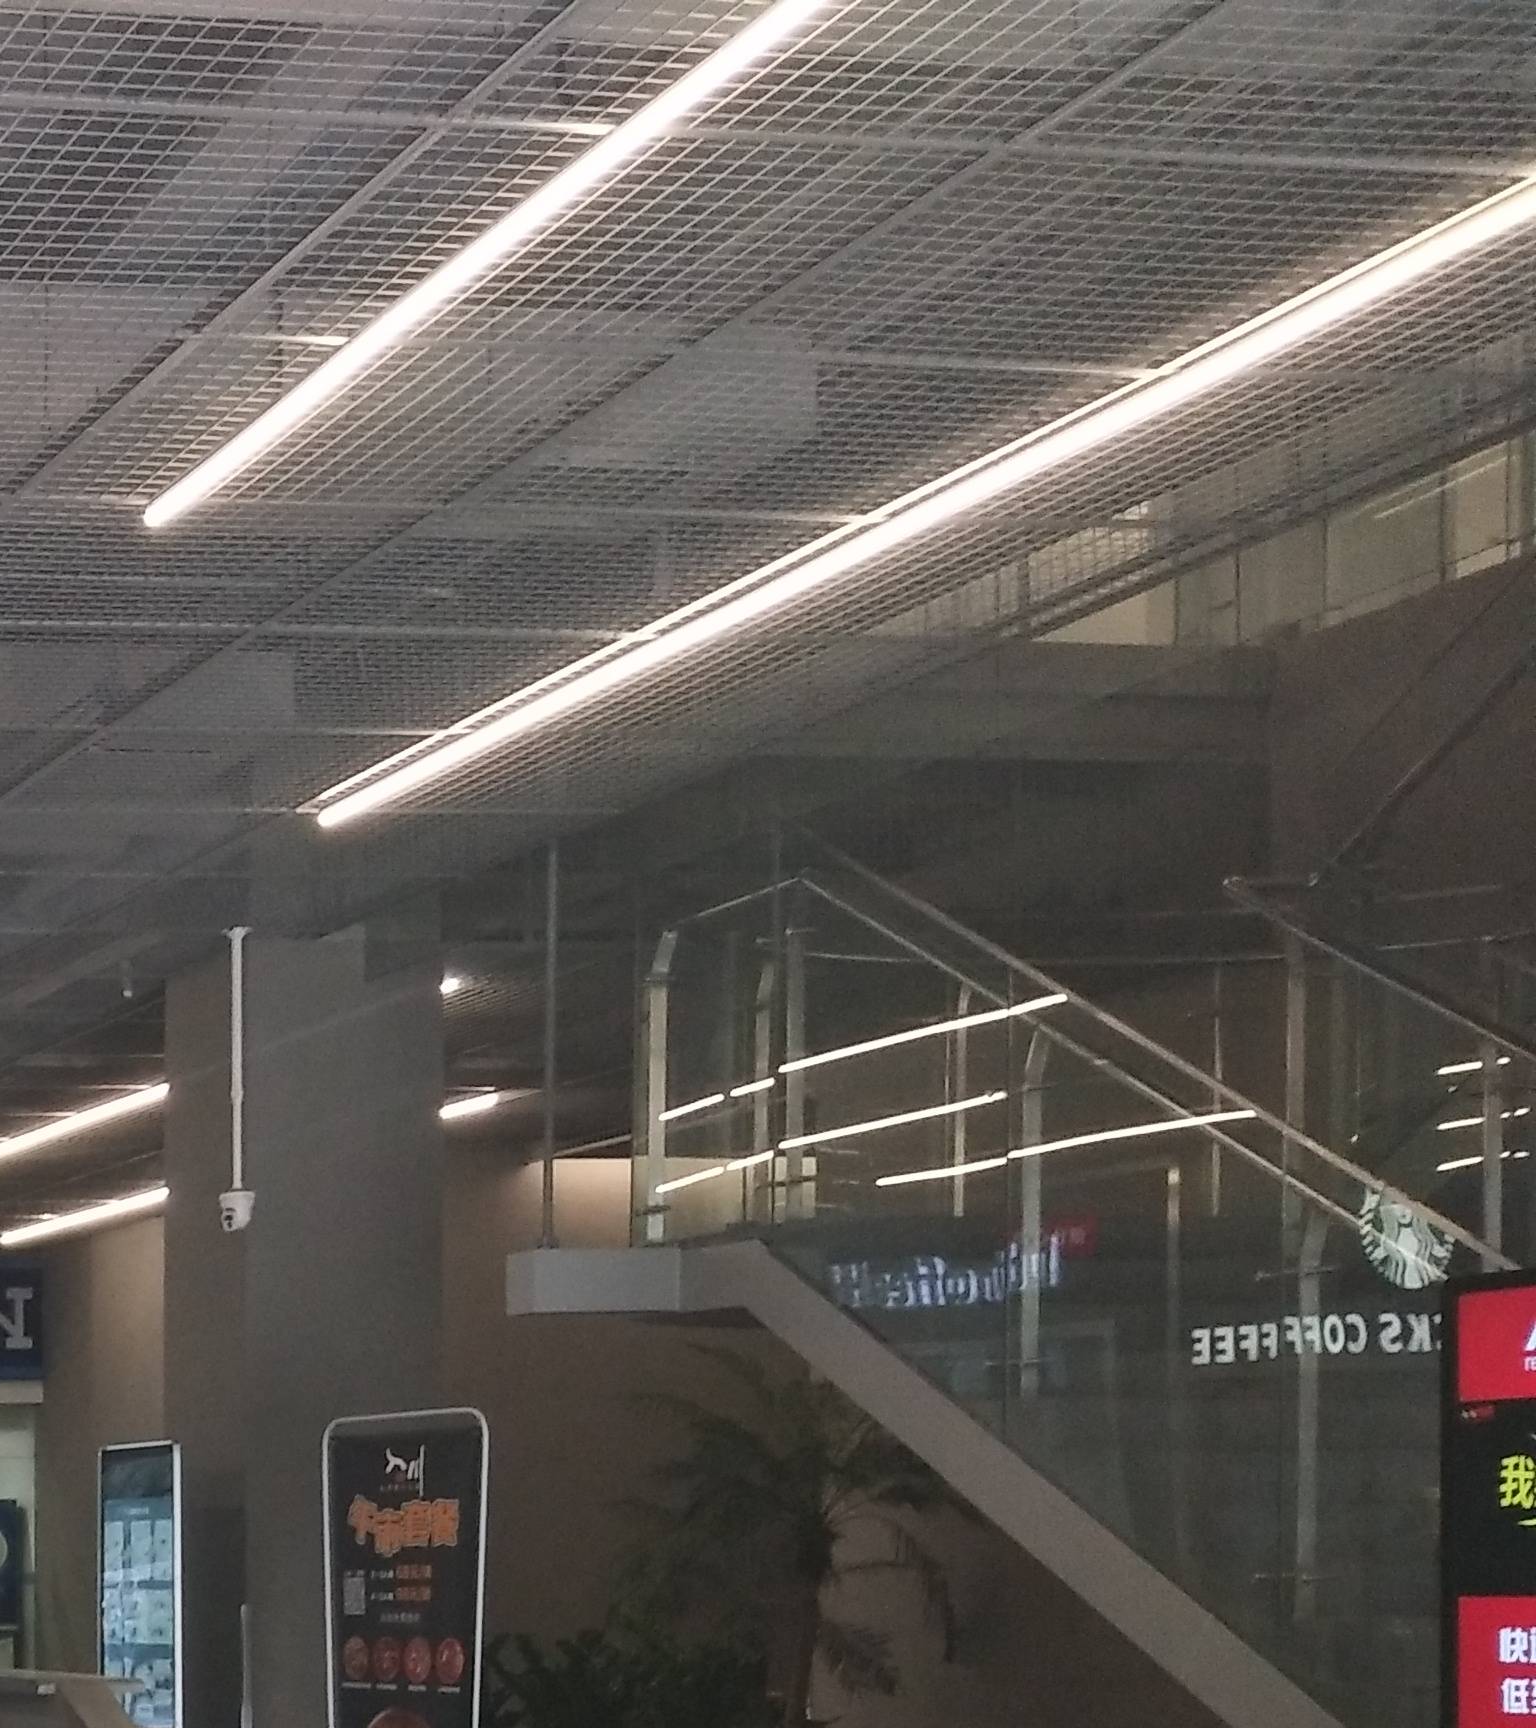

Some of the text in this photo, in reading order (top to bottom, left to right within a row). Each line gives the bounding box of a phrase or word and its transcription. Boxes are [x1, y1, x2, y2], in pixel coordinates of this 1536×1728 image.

[1499, 1455, 1536, 1508] 我
[1499, 1626, 1536, 1664] 快
[1500, 1677, 1536, 1714] 低
